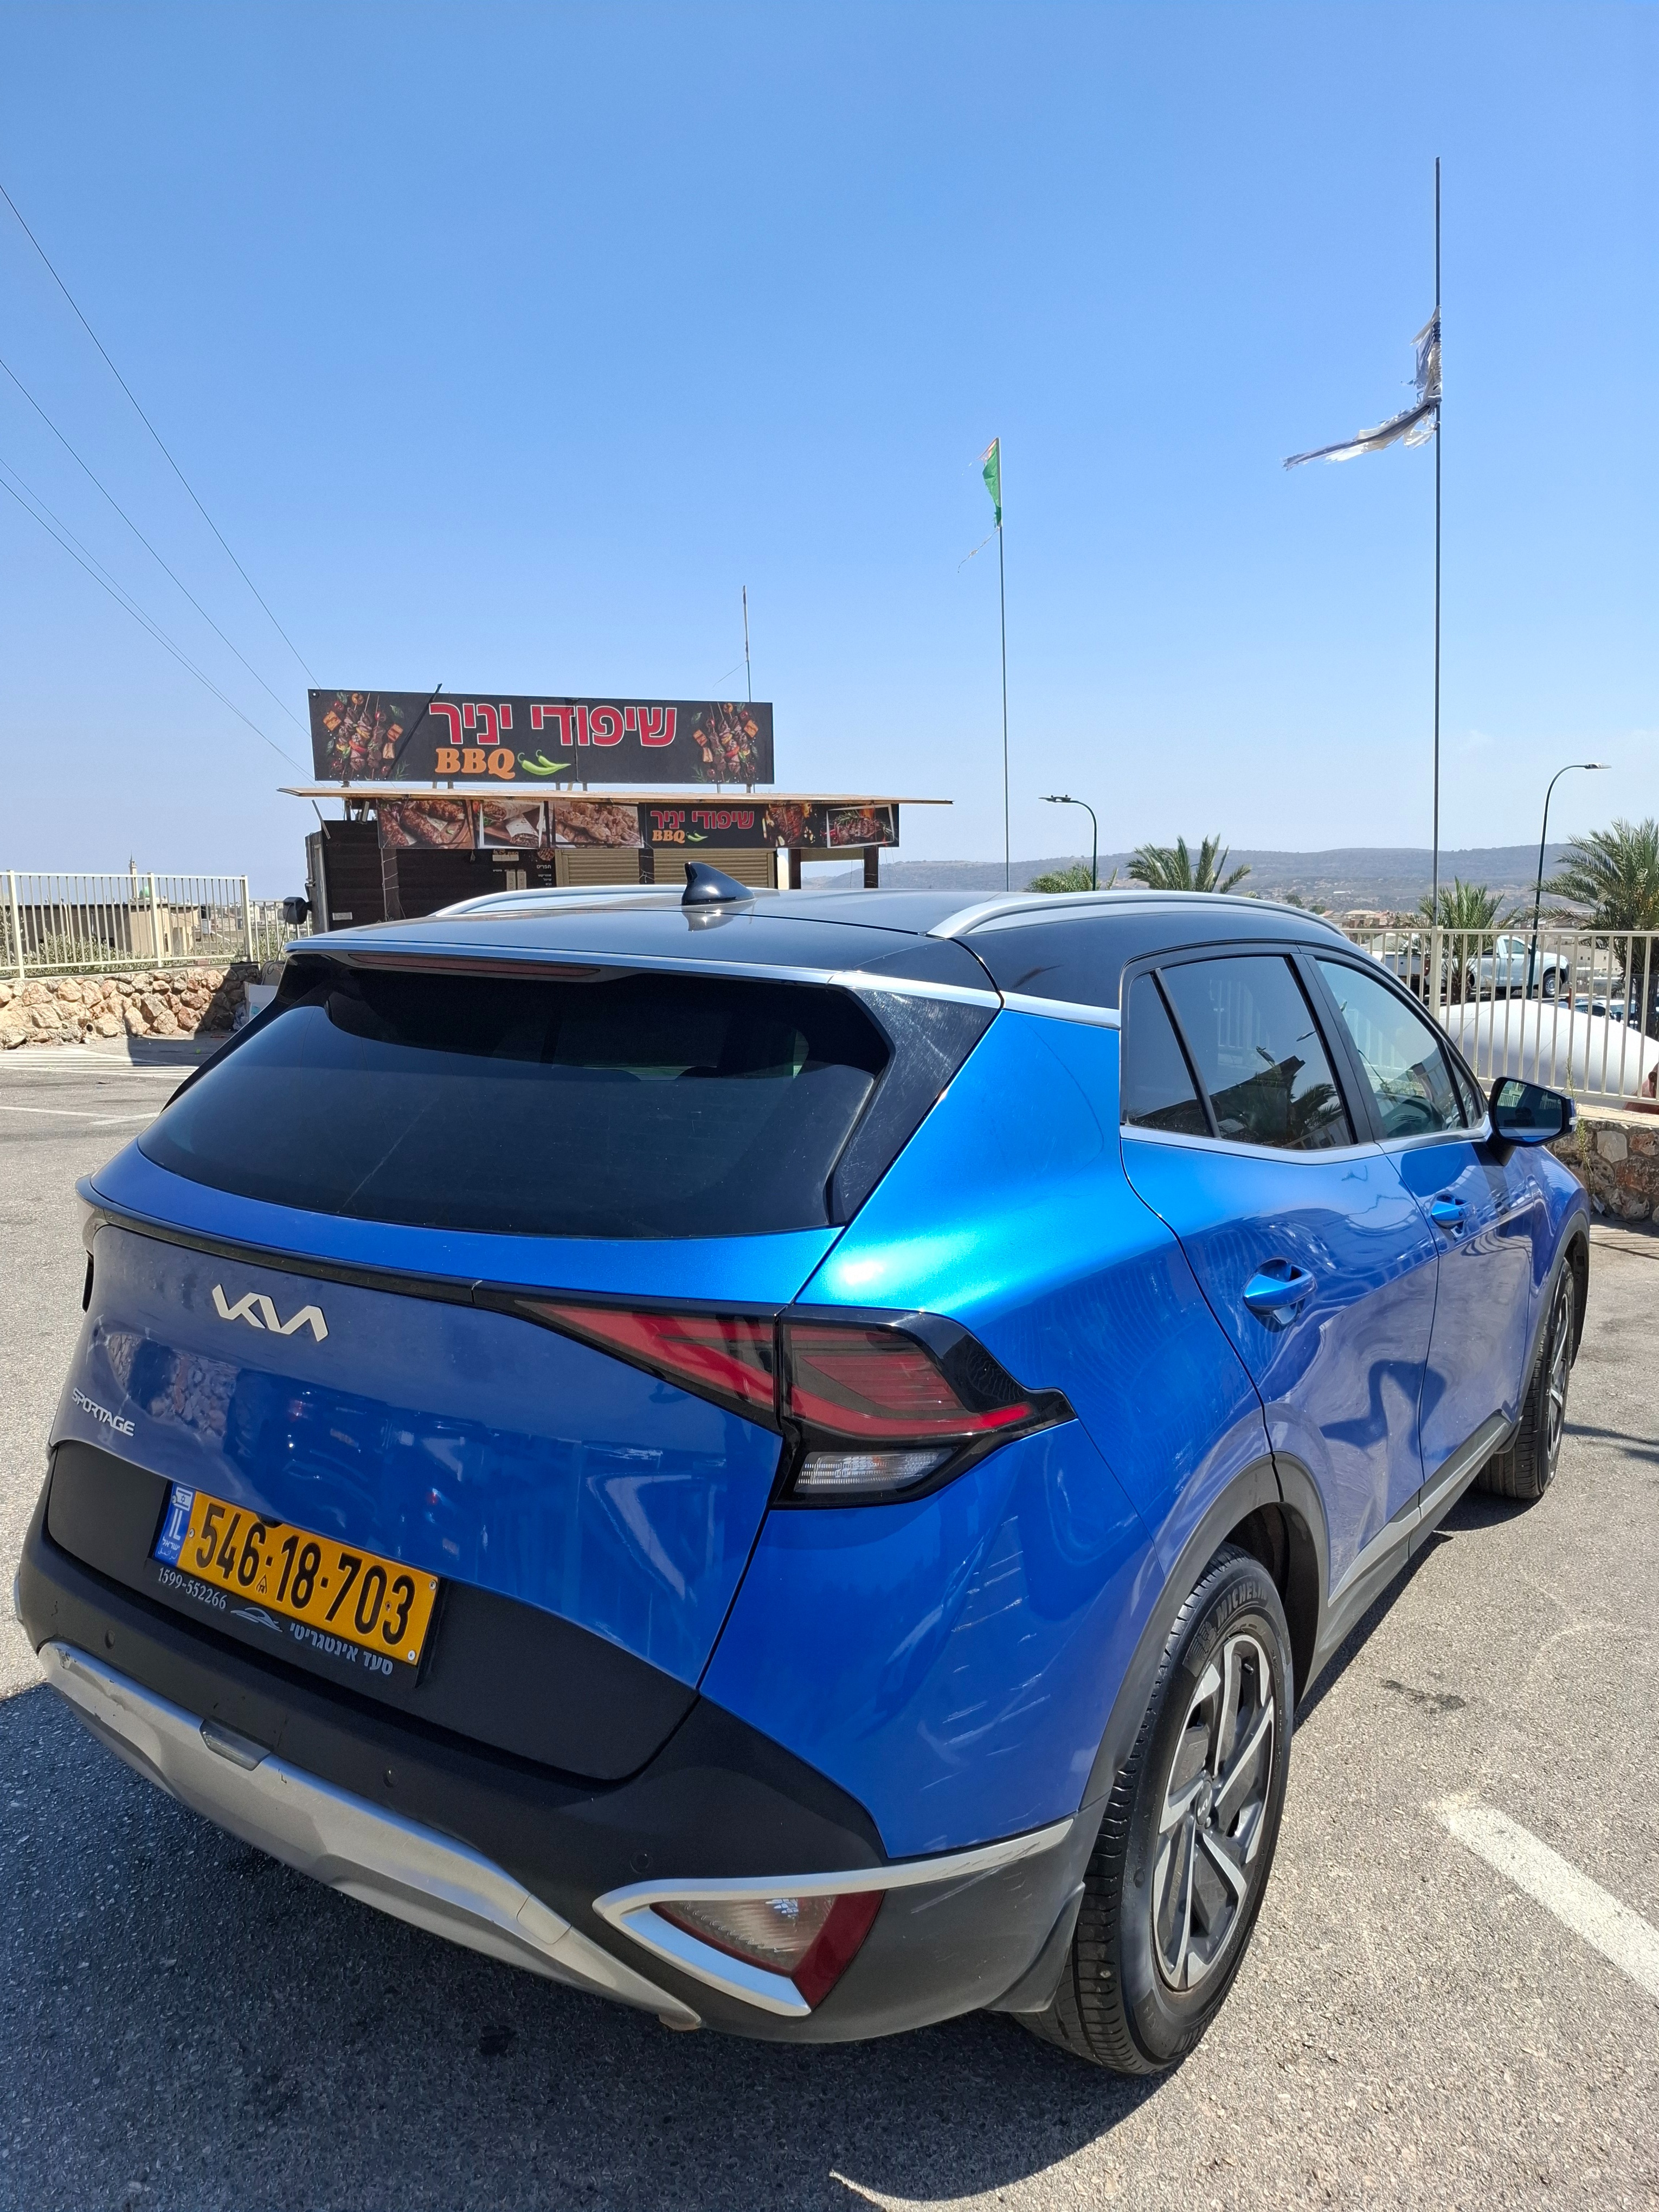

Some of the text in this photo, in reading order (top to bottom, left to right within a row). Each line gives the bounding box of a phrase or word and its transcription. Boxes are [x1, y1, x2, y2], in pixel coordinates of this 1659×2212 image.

[429, 702, 677, 747] שיפודי יניר
[434, 748, 516, 779] BBQ
[651, 811, 755, 829] שיפודי יניר
[652, 830, 685, 844] BBQ
[212, 1284, 329, 1342] KIA
[72, 1387, 135, 1437] SPORTAGE
[162, 1536, 181, 1551] ישראל
[169, 1509, 183, 1541] IL
[158, 1567, 227, 1609] 1599-552266
[1216, 1580, 1267, 1629] MICHELIN
[290, 1623, 393, 1675] סעד אינטגריטי
